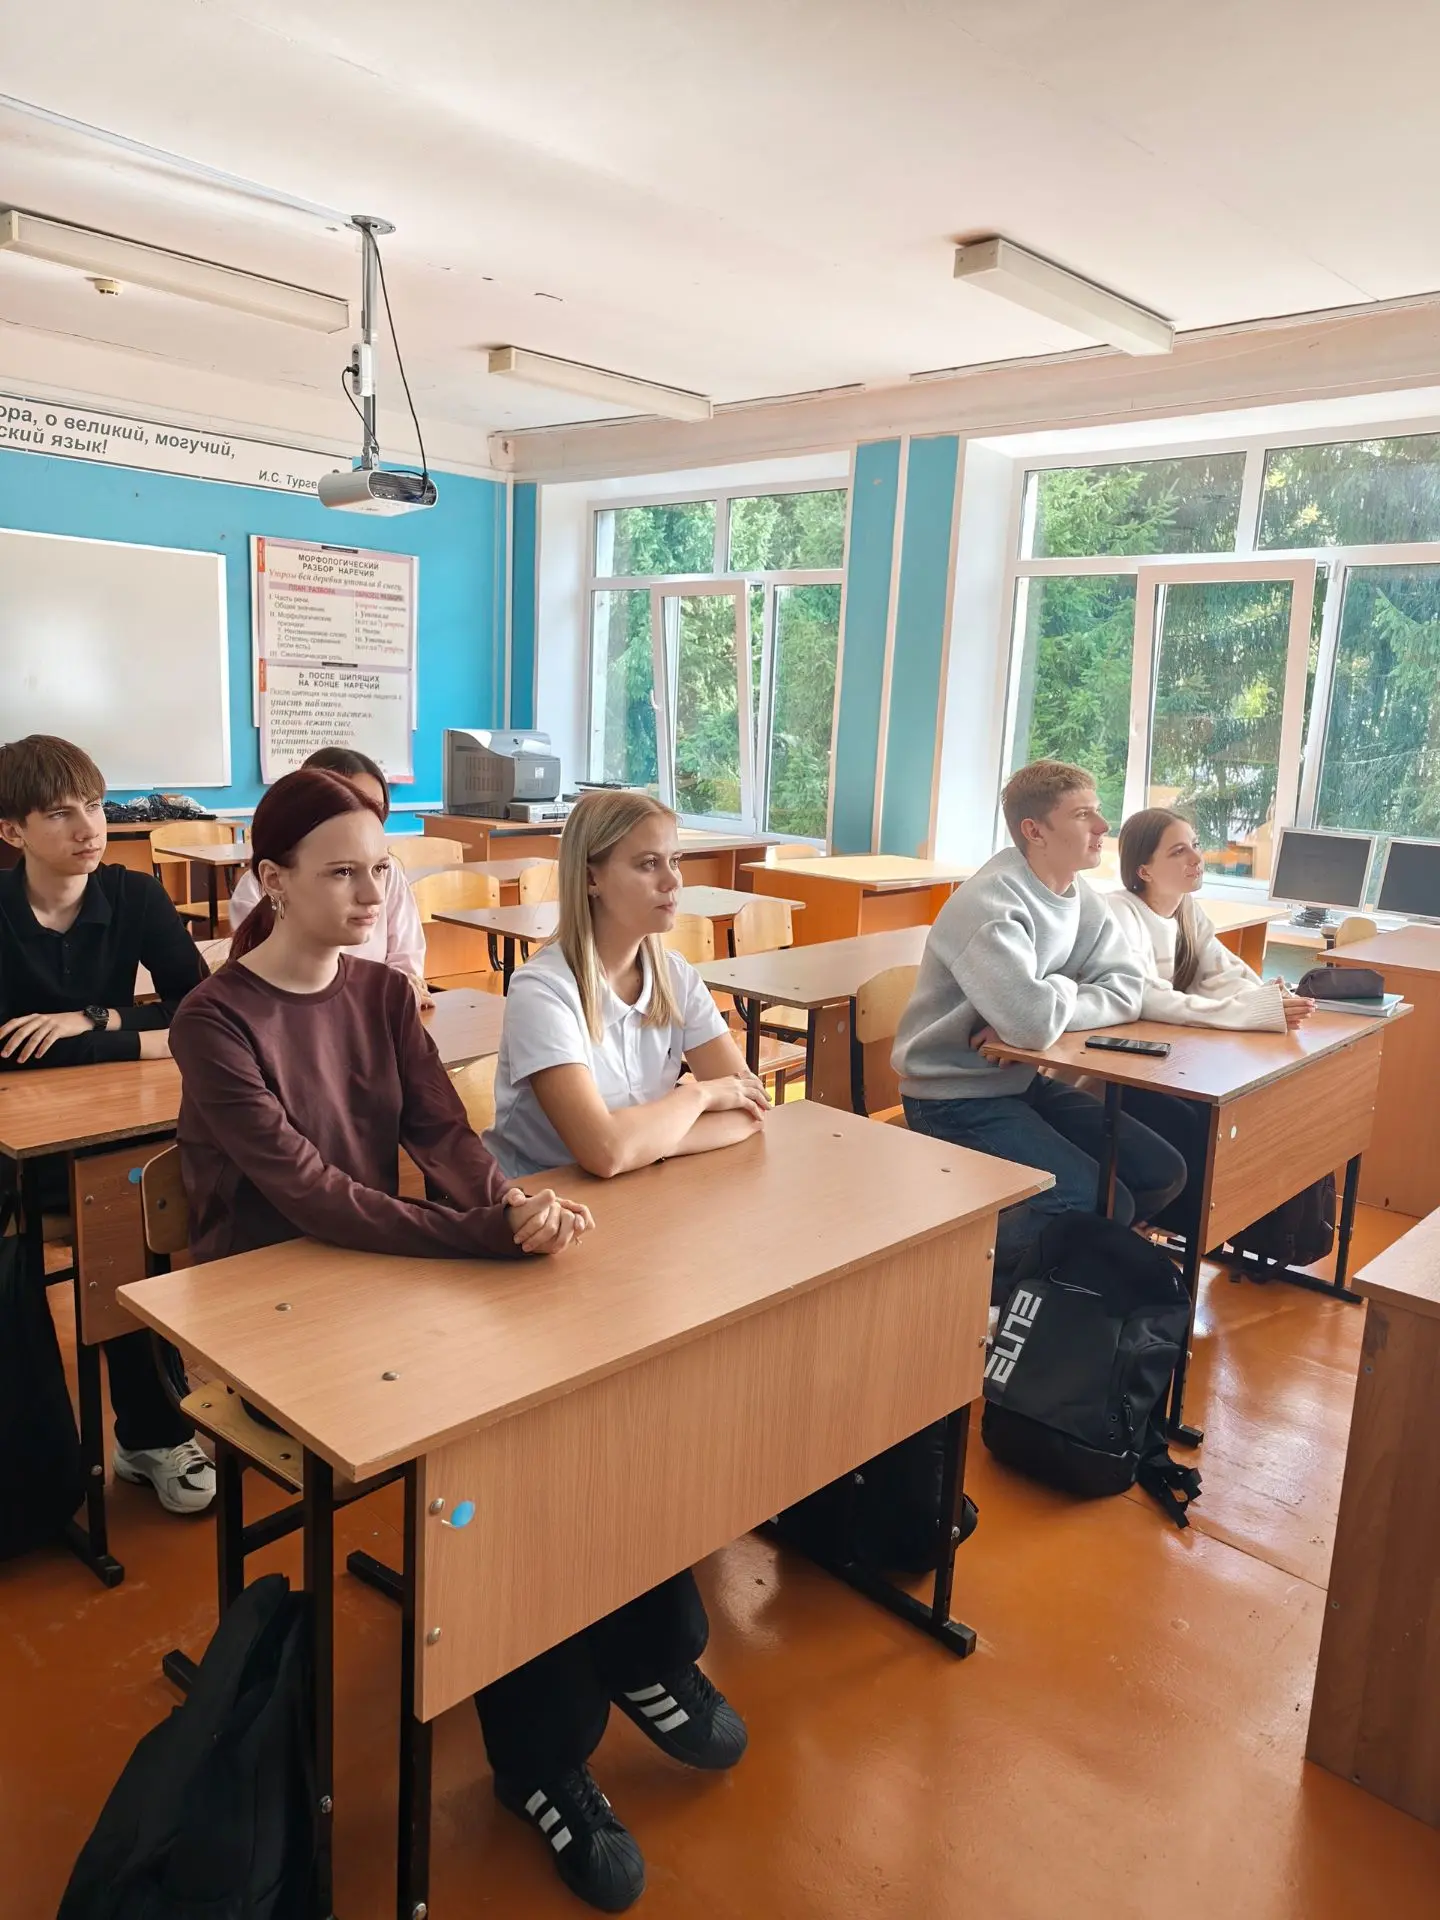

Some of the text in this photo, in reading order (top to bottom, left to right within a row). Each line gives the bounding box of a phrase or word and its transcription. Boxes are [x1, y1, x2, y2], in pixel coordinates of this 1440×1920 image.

[45, 413, 58, 426] о
[64, 417, 149, 445] великий,
[155, 433, 236, 460] могучий,
[51, 434, 108, 454] язык!
[258, 469, 319, 489] И.С. Турге
[298, 553, 379, 570] МОРФОЛОГИЧЕСКИЙ
[302, 562, 375, 577] РАЗБОР НАРЕЧИЯ
[298, 679, 380, 690] НА КОНЦЕ НАРЕЧИЙ
[308, 671, 335, 680] ПОСЛЕ
[339, 673, 380, 683] ШИПЯЩИХ
[270, 709, 313, 719] открыть
[983, 1289, 1042, 1384] ELITE
